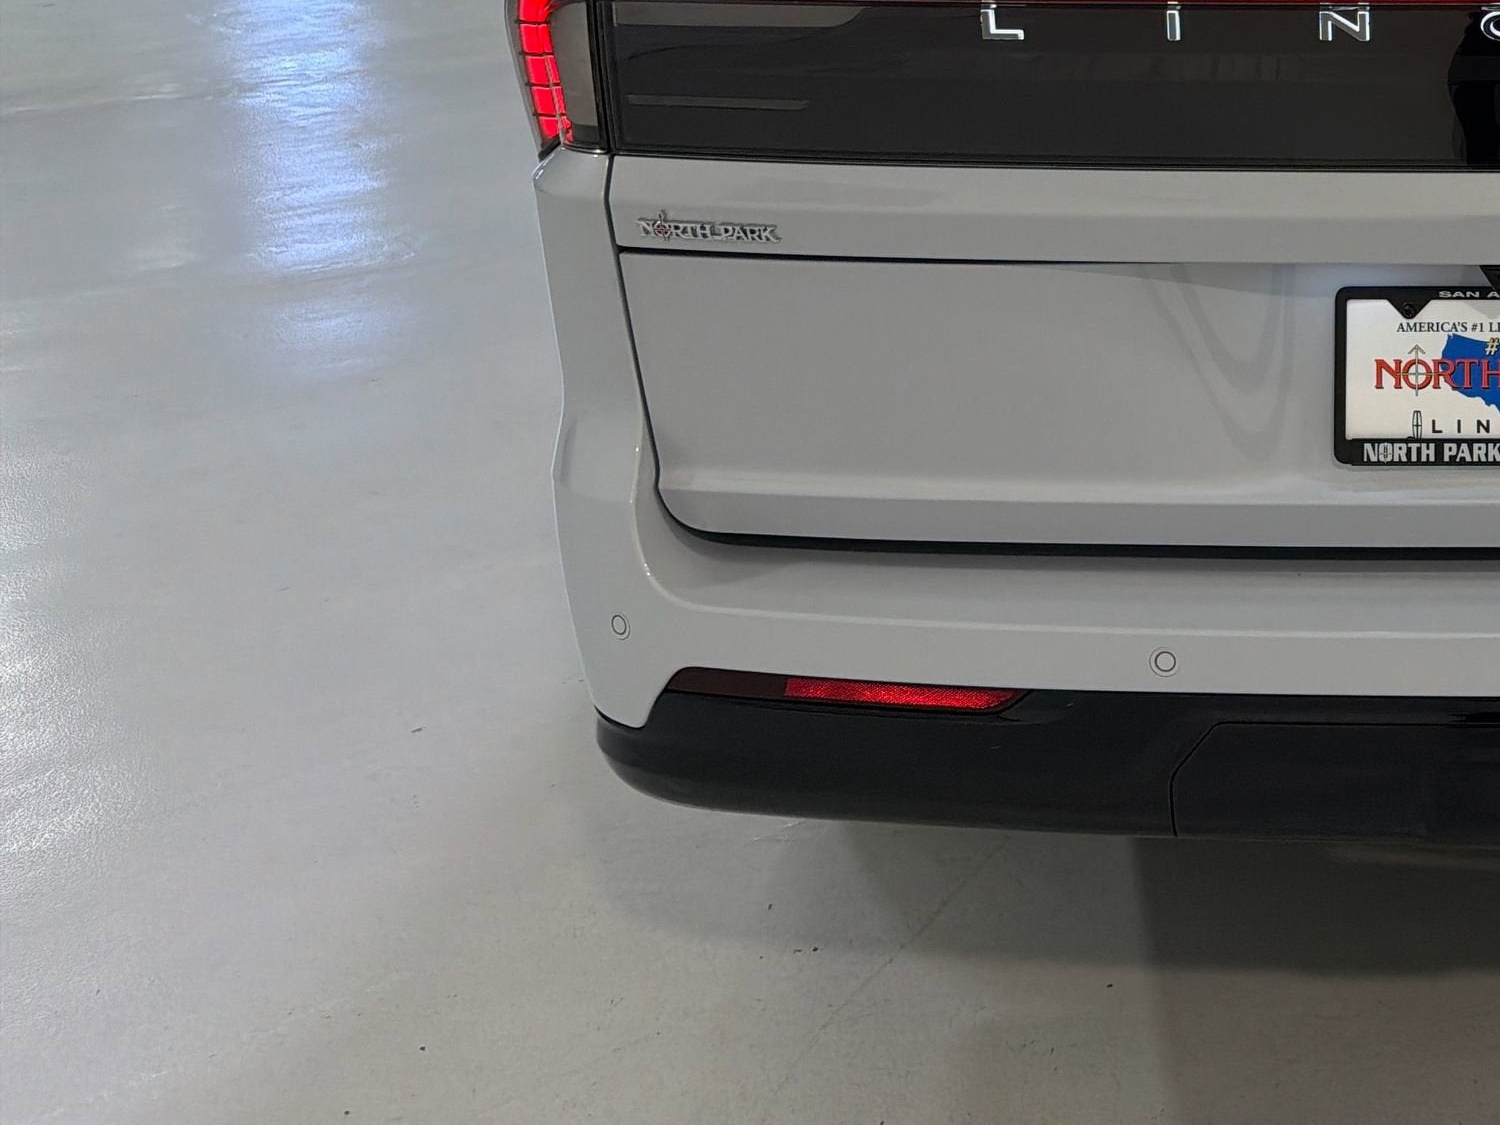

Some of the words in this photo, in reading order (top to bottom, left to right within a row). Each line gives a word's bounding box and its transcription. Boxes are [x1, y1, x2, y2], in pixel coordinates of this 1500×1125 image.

[637, 219, 709, 240] NORTH
[717, 225, 782, 243] PARK
[1438, 291, 1480, 299] SAN
[1397, 321, 1468, 333] AMERICA'S
[1471, 321, 1484, 333] #1
[1363, 442, 1435, 463] NORTH
